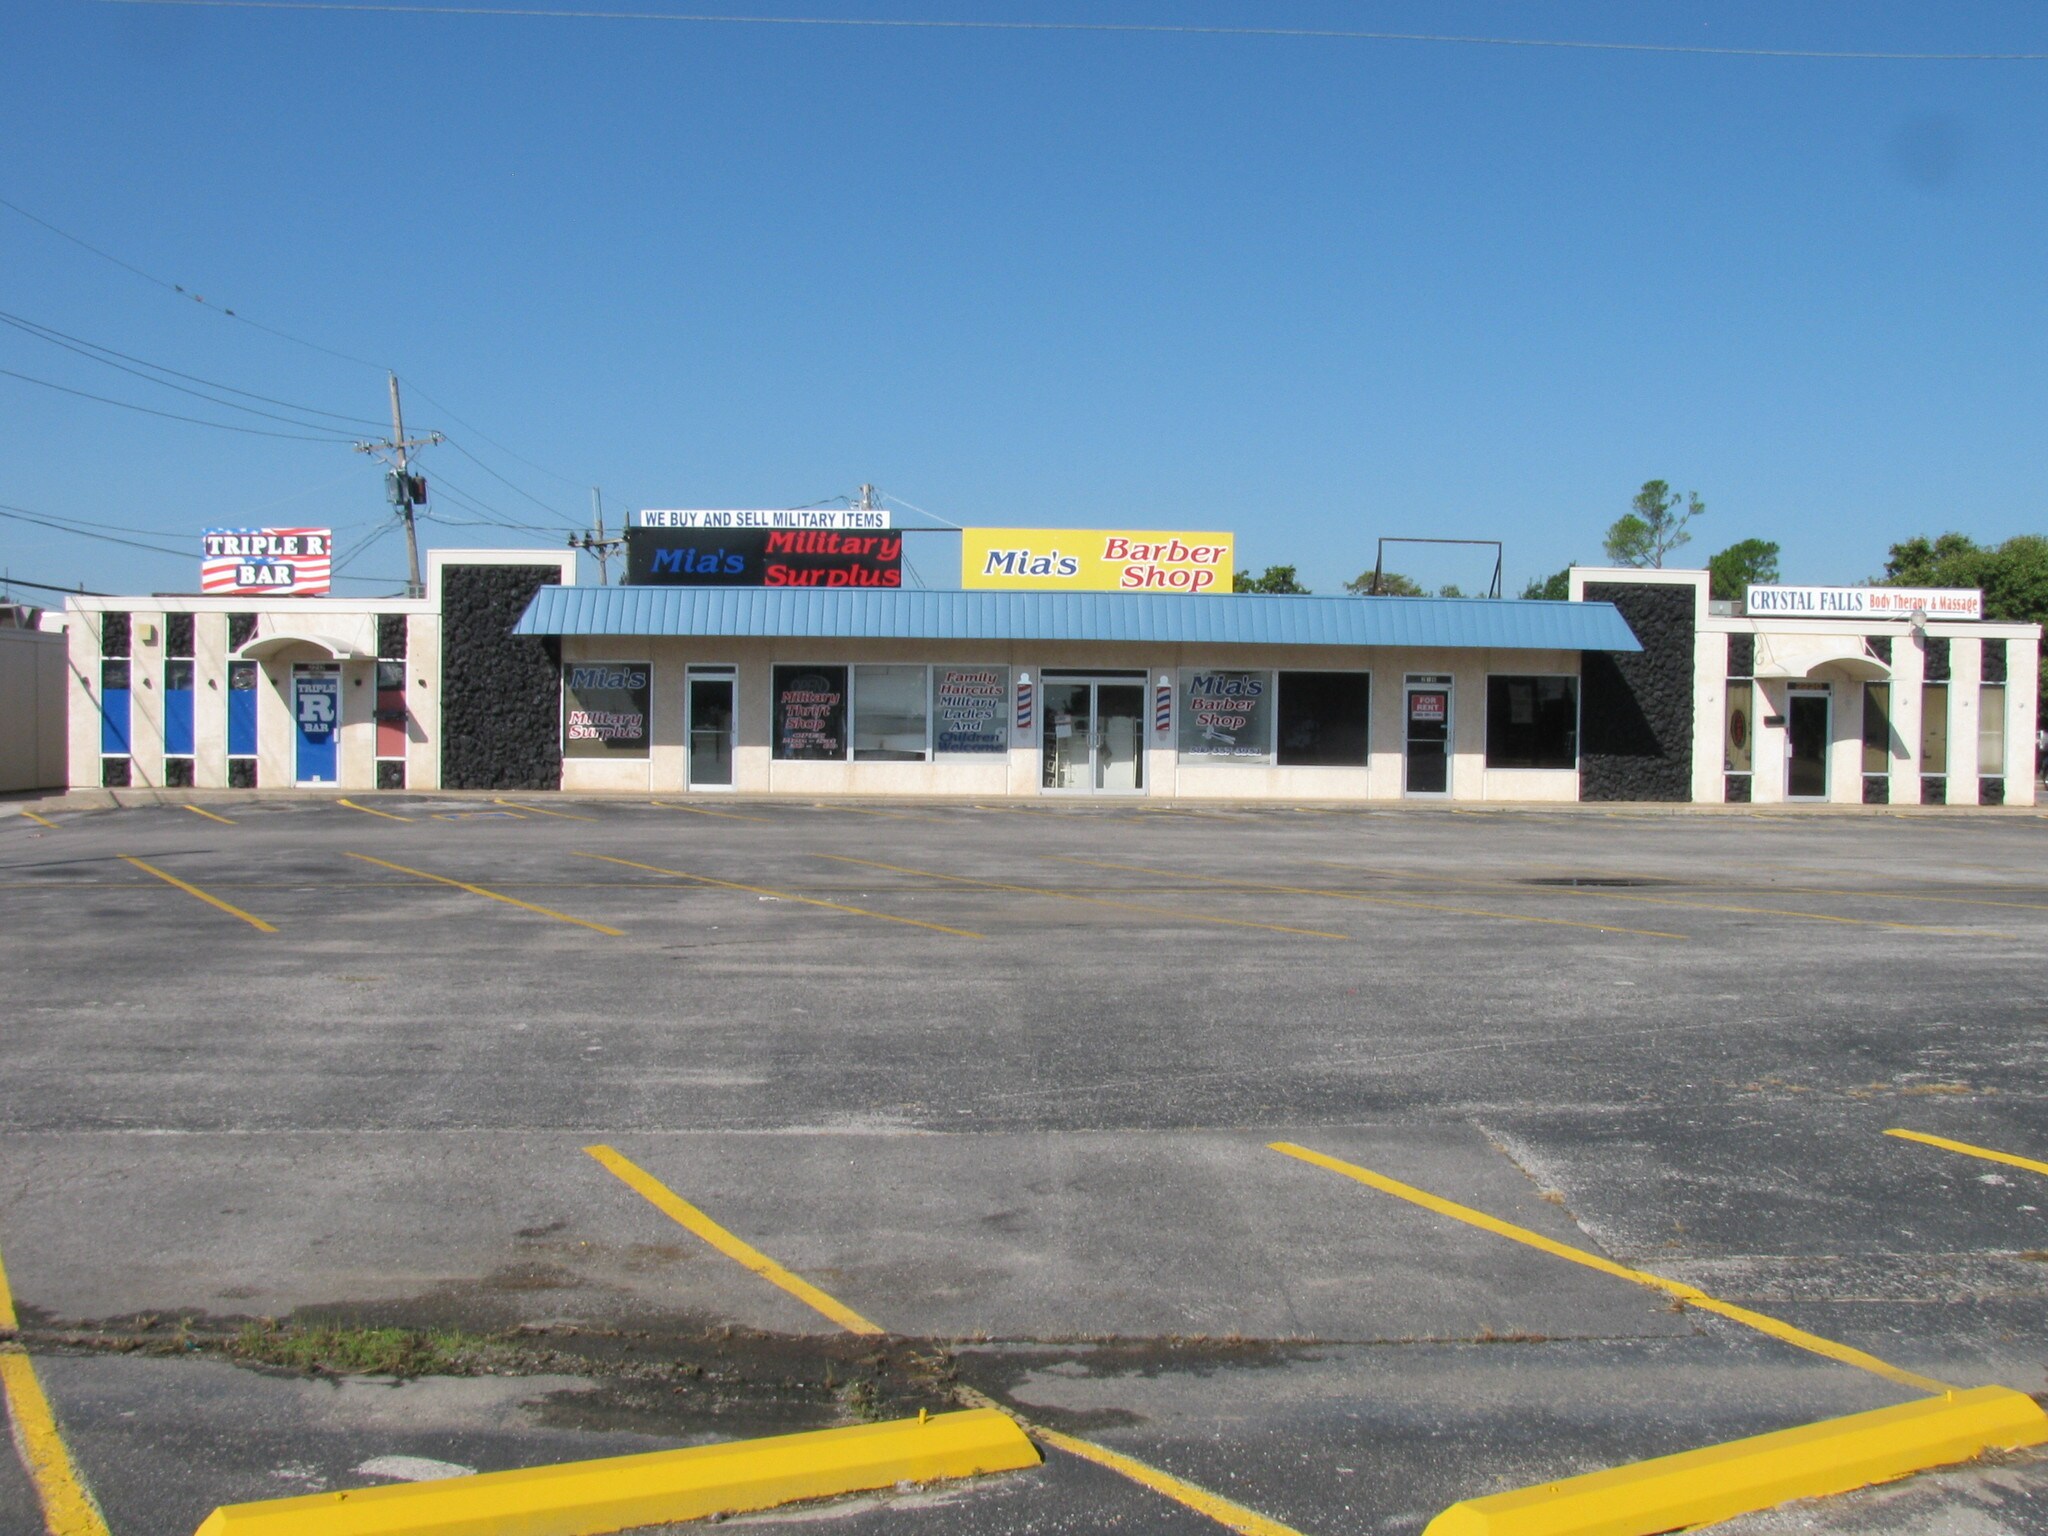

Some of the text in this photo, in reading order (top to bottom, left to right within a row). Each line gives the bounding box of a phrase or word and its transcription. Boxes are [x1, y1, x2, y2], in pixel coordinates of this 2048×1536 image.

[645, 512, 883, 528] WE BUY AND SELL MILITARY ITEMS
[207, 536, 324, 555] TRIPLE R
[764, 531, 901, 561] Military
[1103, 537, 1228, 564] Barber
[651, 548, 745, 574] Mia's
[983, 549, 1078, 576] Mia's
[239, 565, 291, 585] BAR
[764, 564, 901, 587] Surplus
[1121, 565, 1215, 593] Shop
[1750, 590, 1863, 612] CRYSTAL FALLS
[1869, 593, 1978, 614] Body Therapy & Massage
[571, 667, 647, 690] Mia's
[945, 671, 998, 686] Family
[1189, 675, 1264, 697] Mia's
[298, 684, 337, 693] TRIPLE
[939, 683, 1004, 697] Haircuts
[781, 691, 841, 706] Military
[939, 696, 998, 710] Military
[1190, 697, 1256, 712] Barber
[299, 694, 335, 722] R
[785, 704, 831, 718] Thrift
[942, 708, 994, 720] Ladies
[569, 711, 643, 727] Military
[785, 717, 826, 732] Shop
[949, 720, 983, 732] And
[1196, 713, 1246, 729] Shop
[304, 723, 329, 733] BAR
[569, 725, 643, 741] Surplus
[939, 731, 1000, 743] Children
[937, 741, 1004, 753] Welcome
